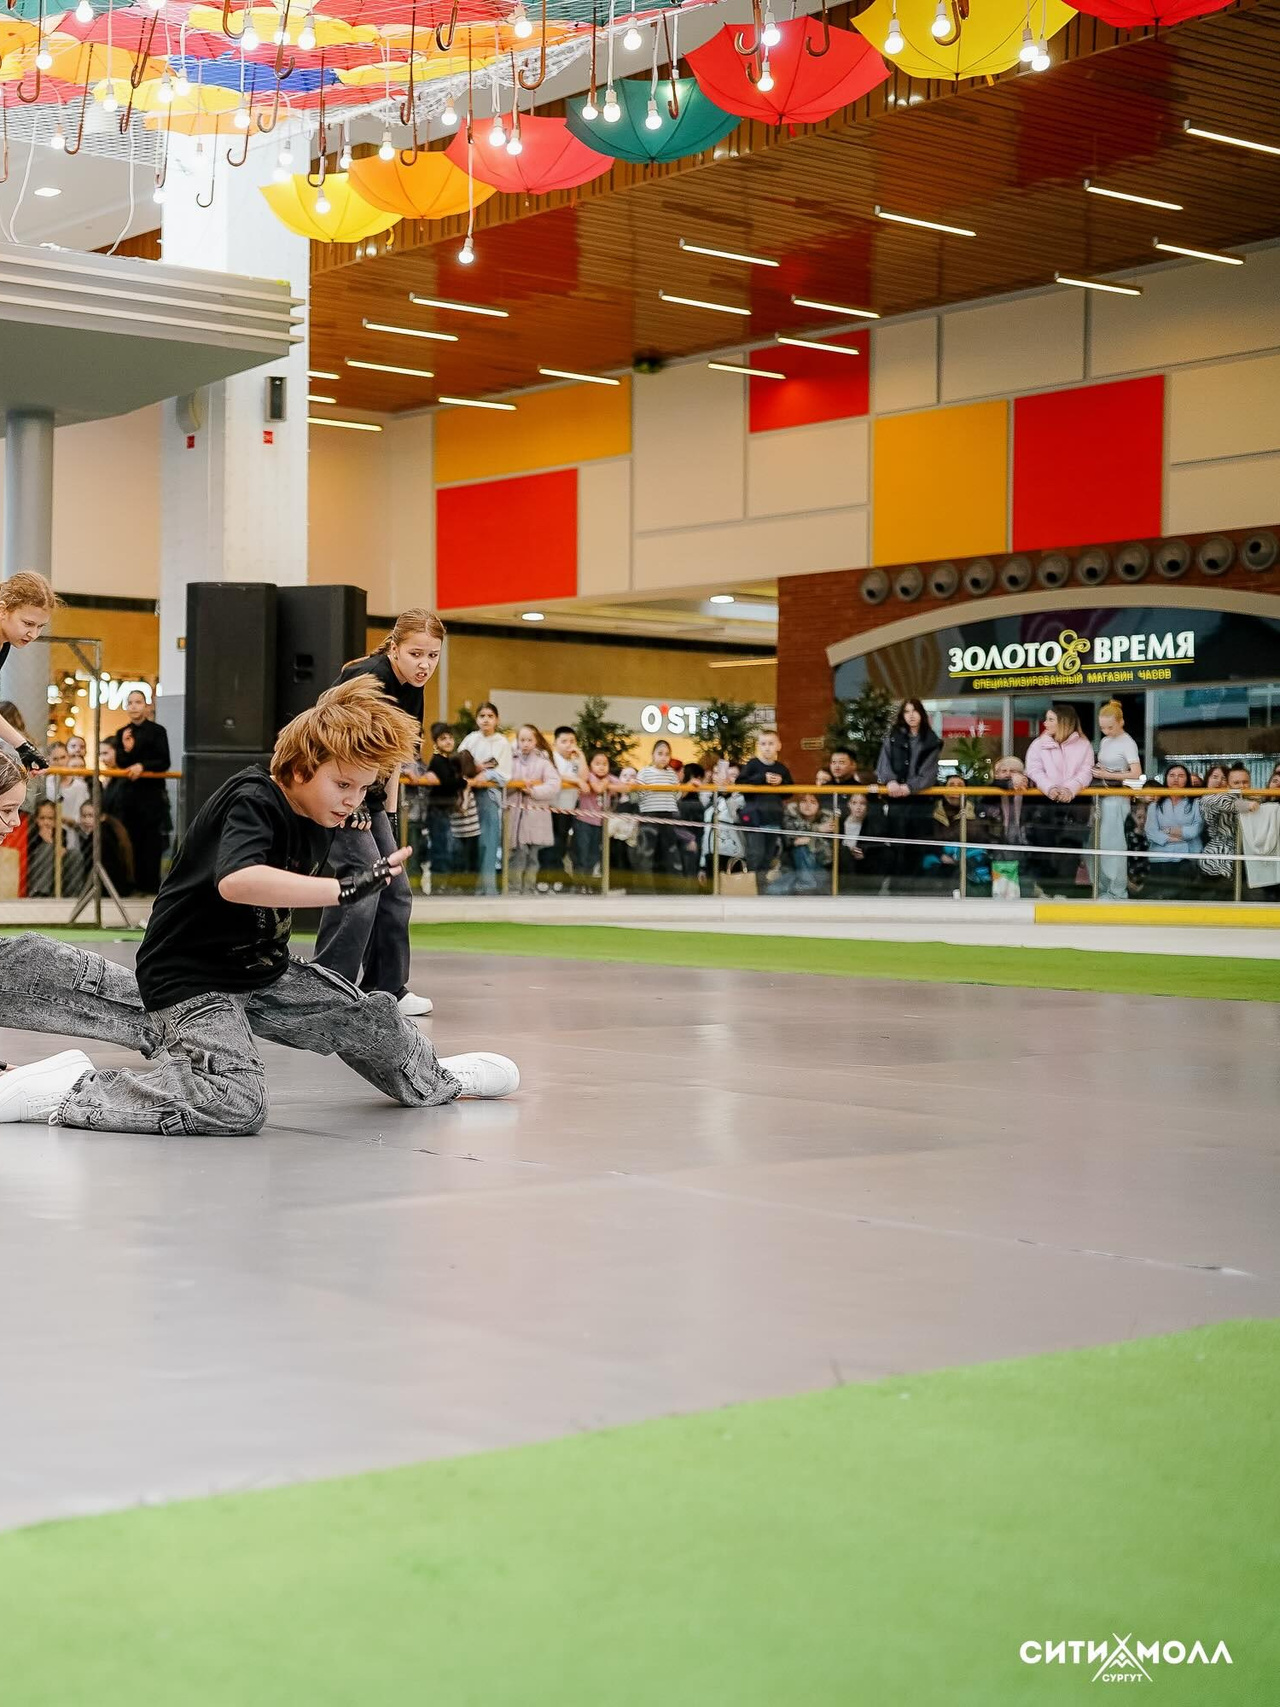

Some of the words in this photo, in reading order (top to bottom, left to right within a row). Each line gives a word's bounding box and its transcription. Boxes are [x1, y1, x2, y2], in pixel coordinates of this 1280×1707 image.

[948, 641, 1062, 673] ЗОЛОТО
[1093, 631, 1195, 664] ВРЕМЯ
[973, 674, 1083, 690] СПЕЦИАЛИЗИРОВАННЫЙ
[1087, 670, 1134, 684] МАГАЗИН
[1138, 669, 1172, 680] ЧАСОВ
